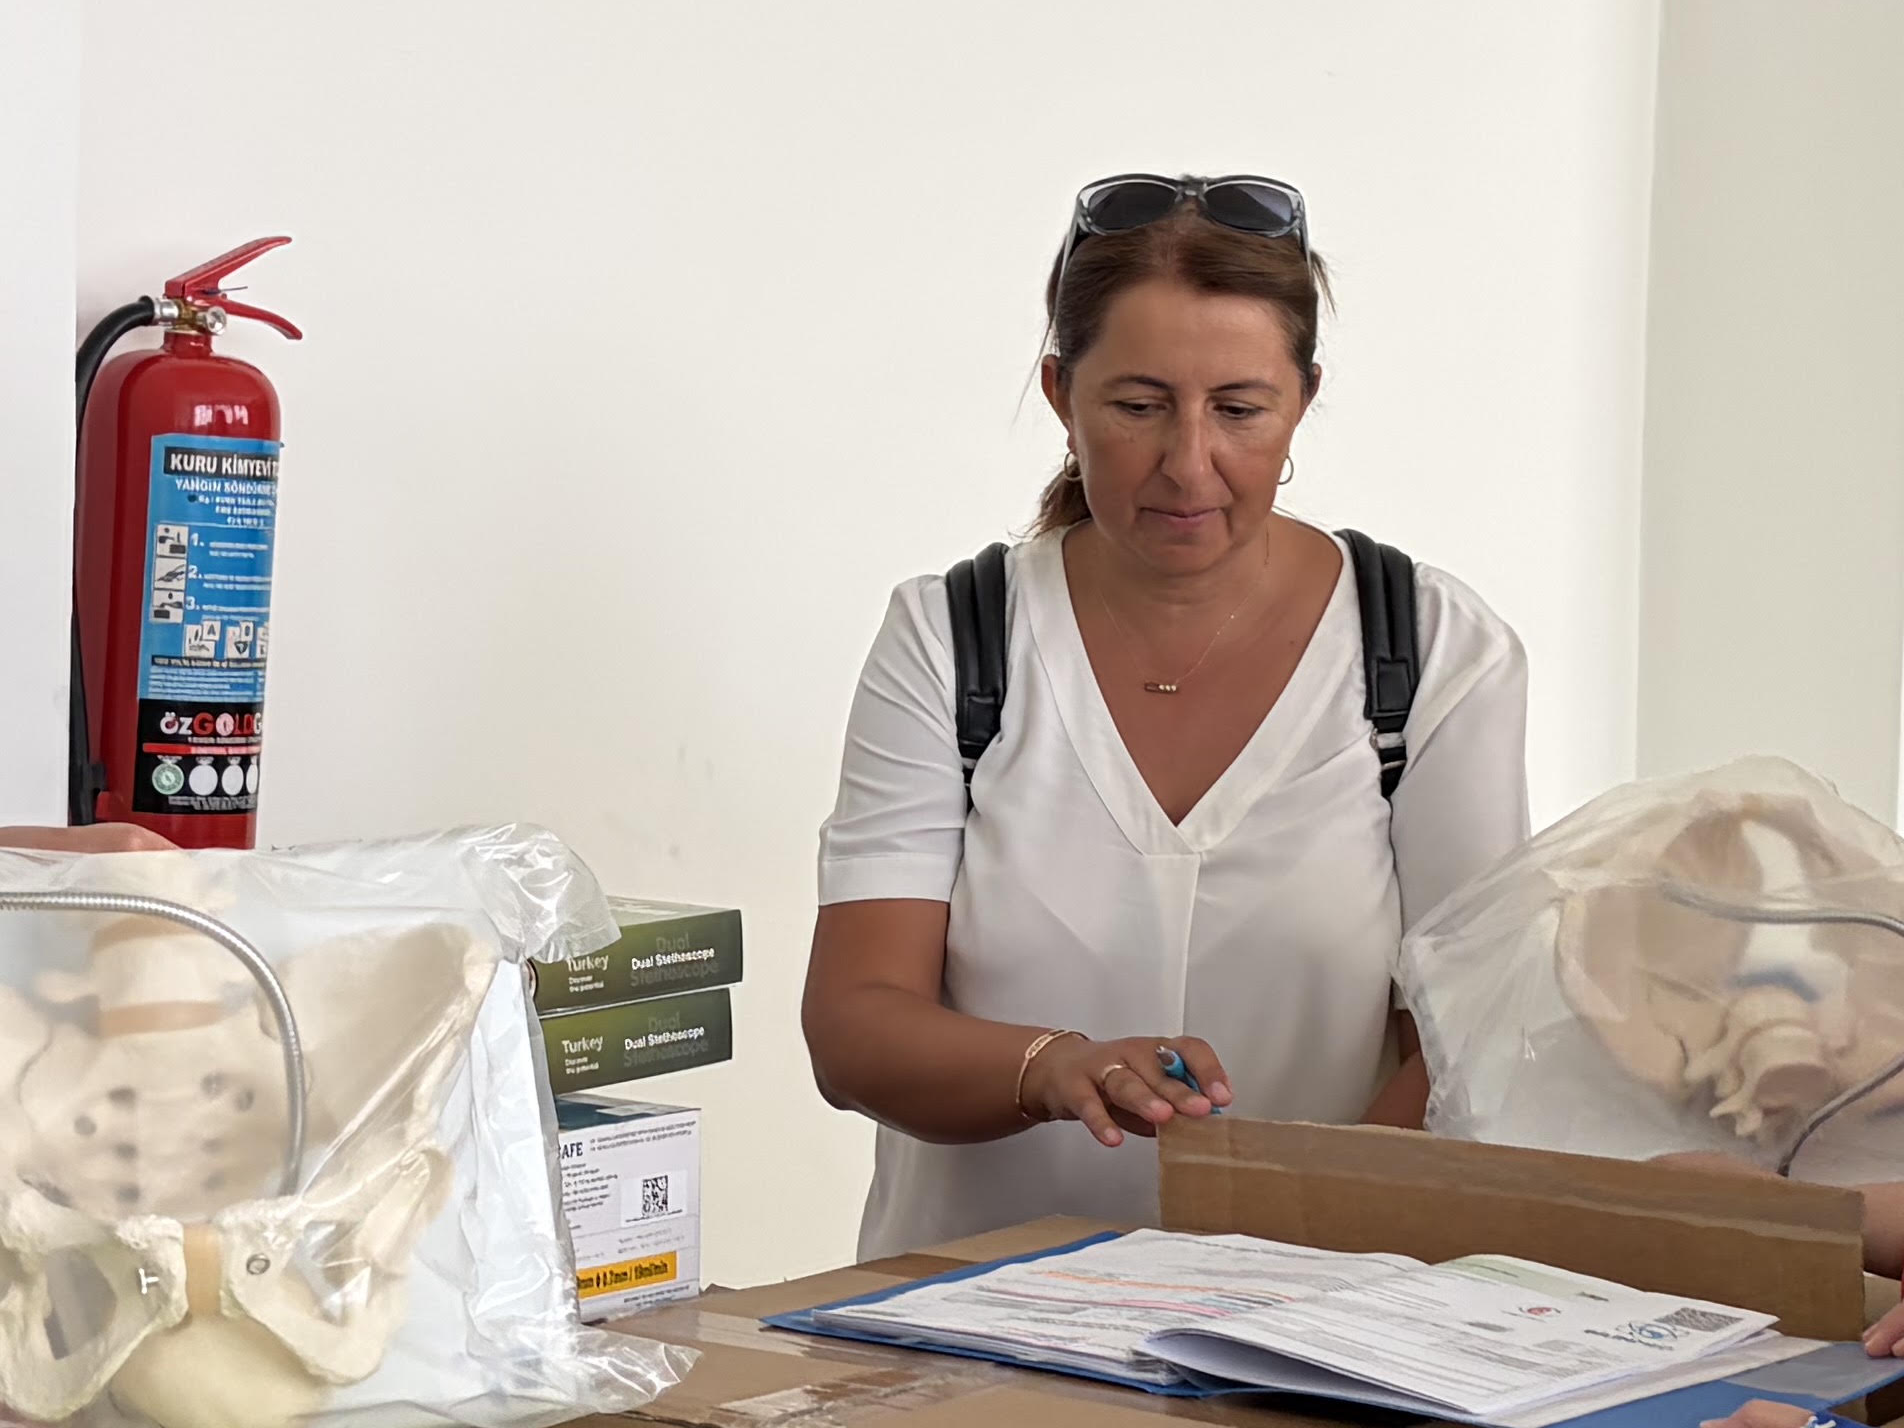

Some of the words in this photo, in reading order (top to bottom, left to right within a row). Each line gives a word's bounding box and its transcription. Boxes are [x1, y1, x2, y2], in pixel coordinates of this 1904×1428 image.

[170, 454, 217, 474] KURU
[566, 955, 609, 972] Turkey
[632, 954, 653, 970] Dual
[562, 1036, 603, 1053] Turkey
[625, 1036, 646, 1051] Dual
